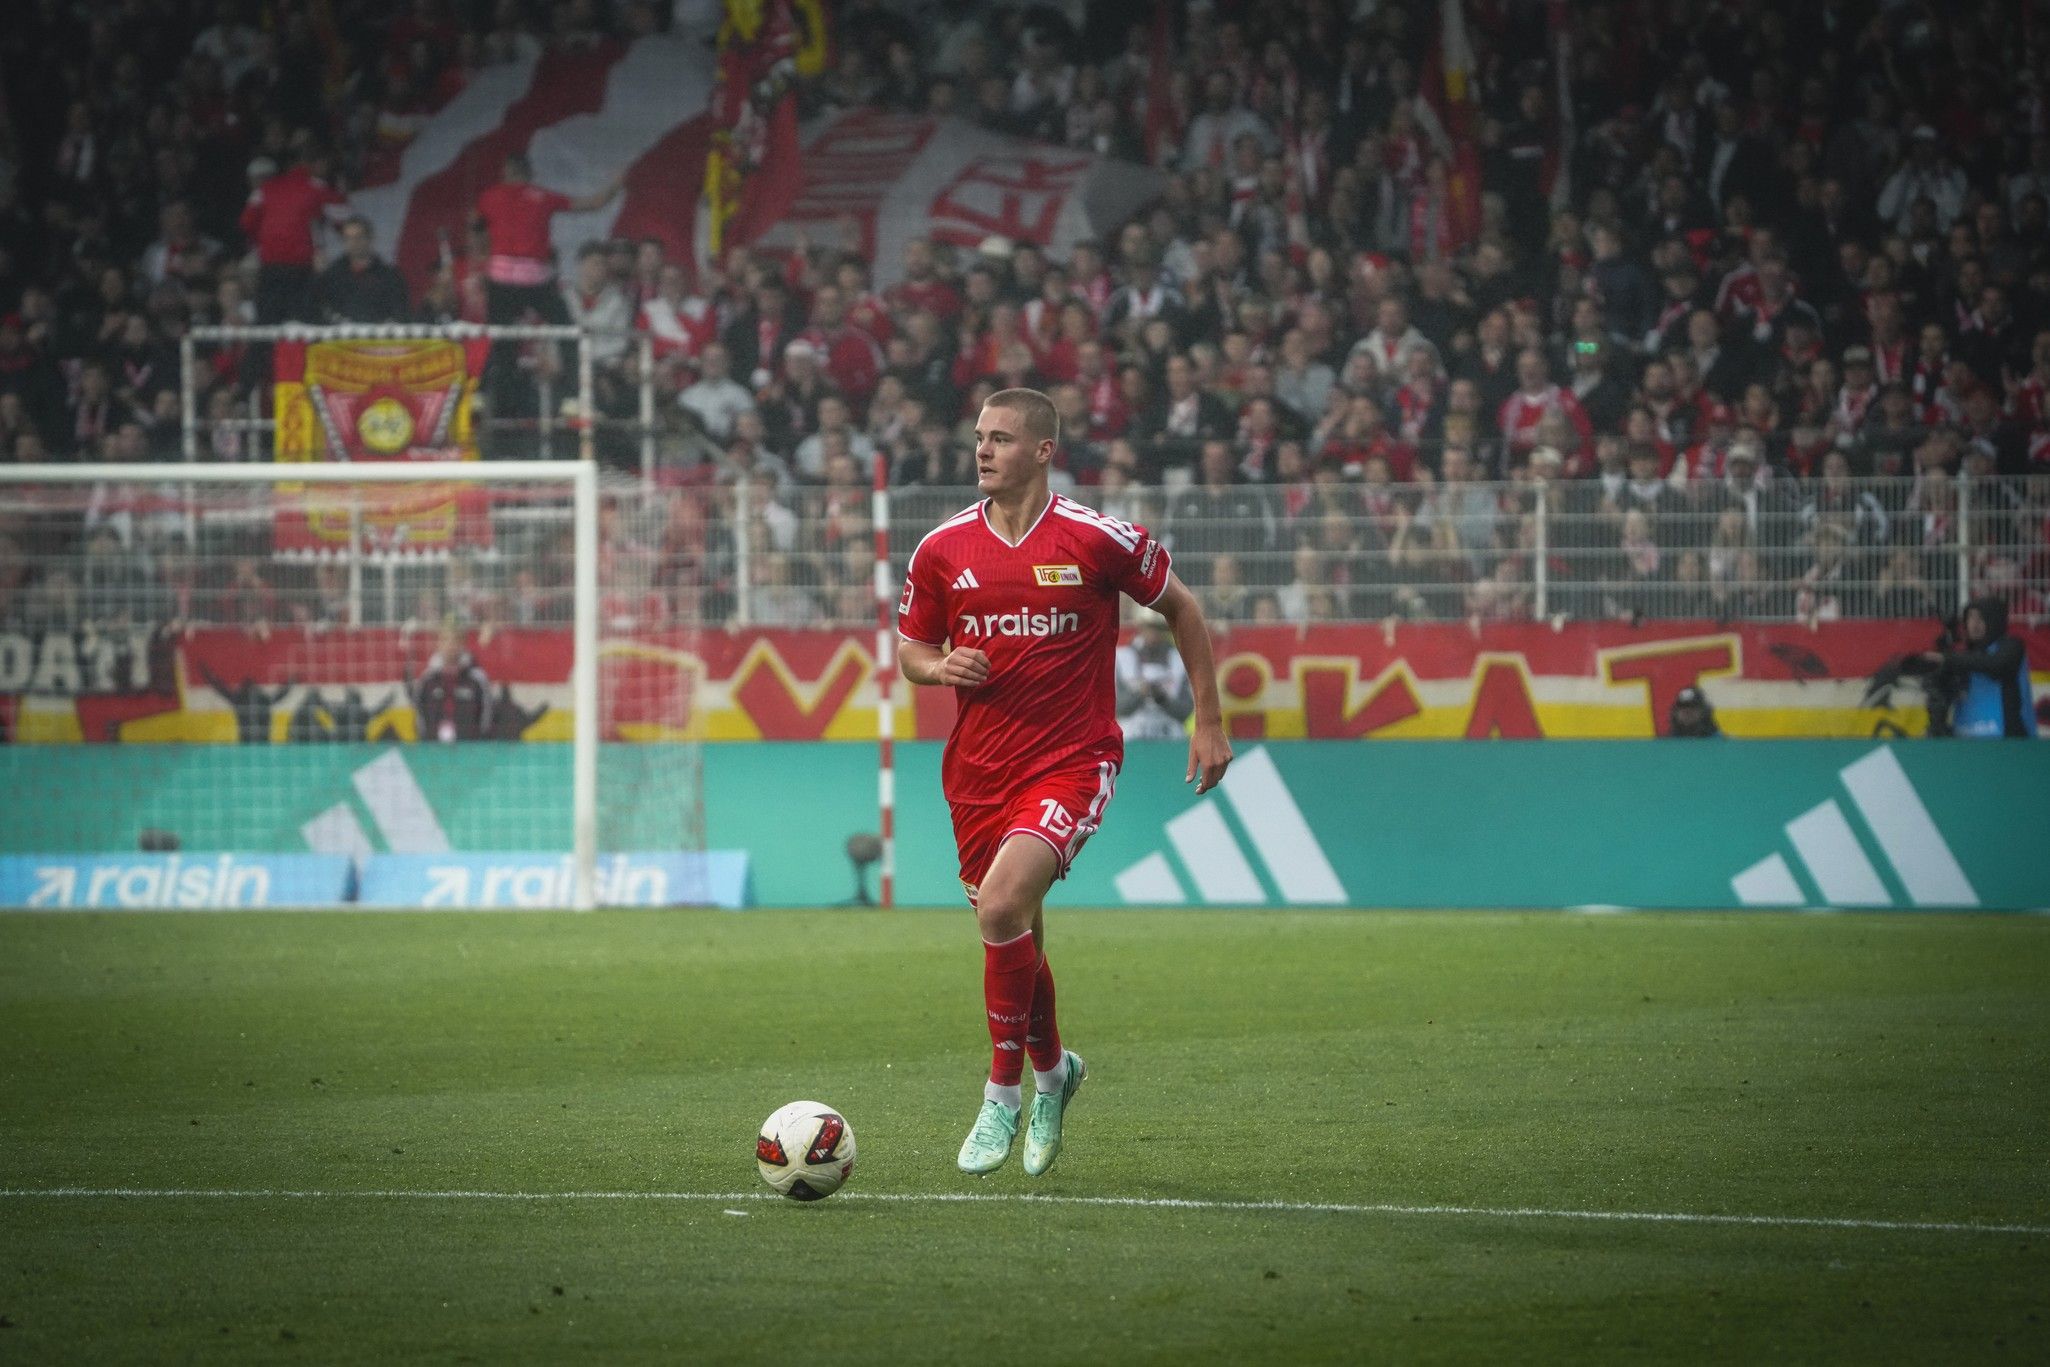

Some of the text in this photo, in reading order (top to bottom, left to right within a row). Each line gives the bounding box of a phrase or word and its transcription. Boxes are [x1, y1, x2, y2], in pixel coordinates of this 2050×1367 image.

[984, 606, 1078, 637] raisin
[1039, 798, 1073, 838] 15
[84, 851, 270, 908] raisin
[479, 851, 668, 909] raiin
